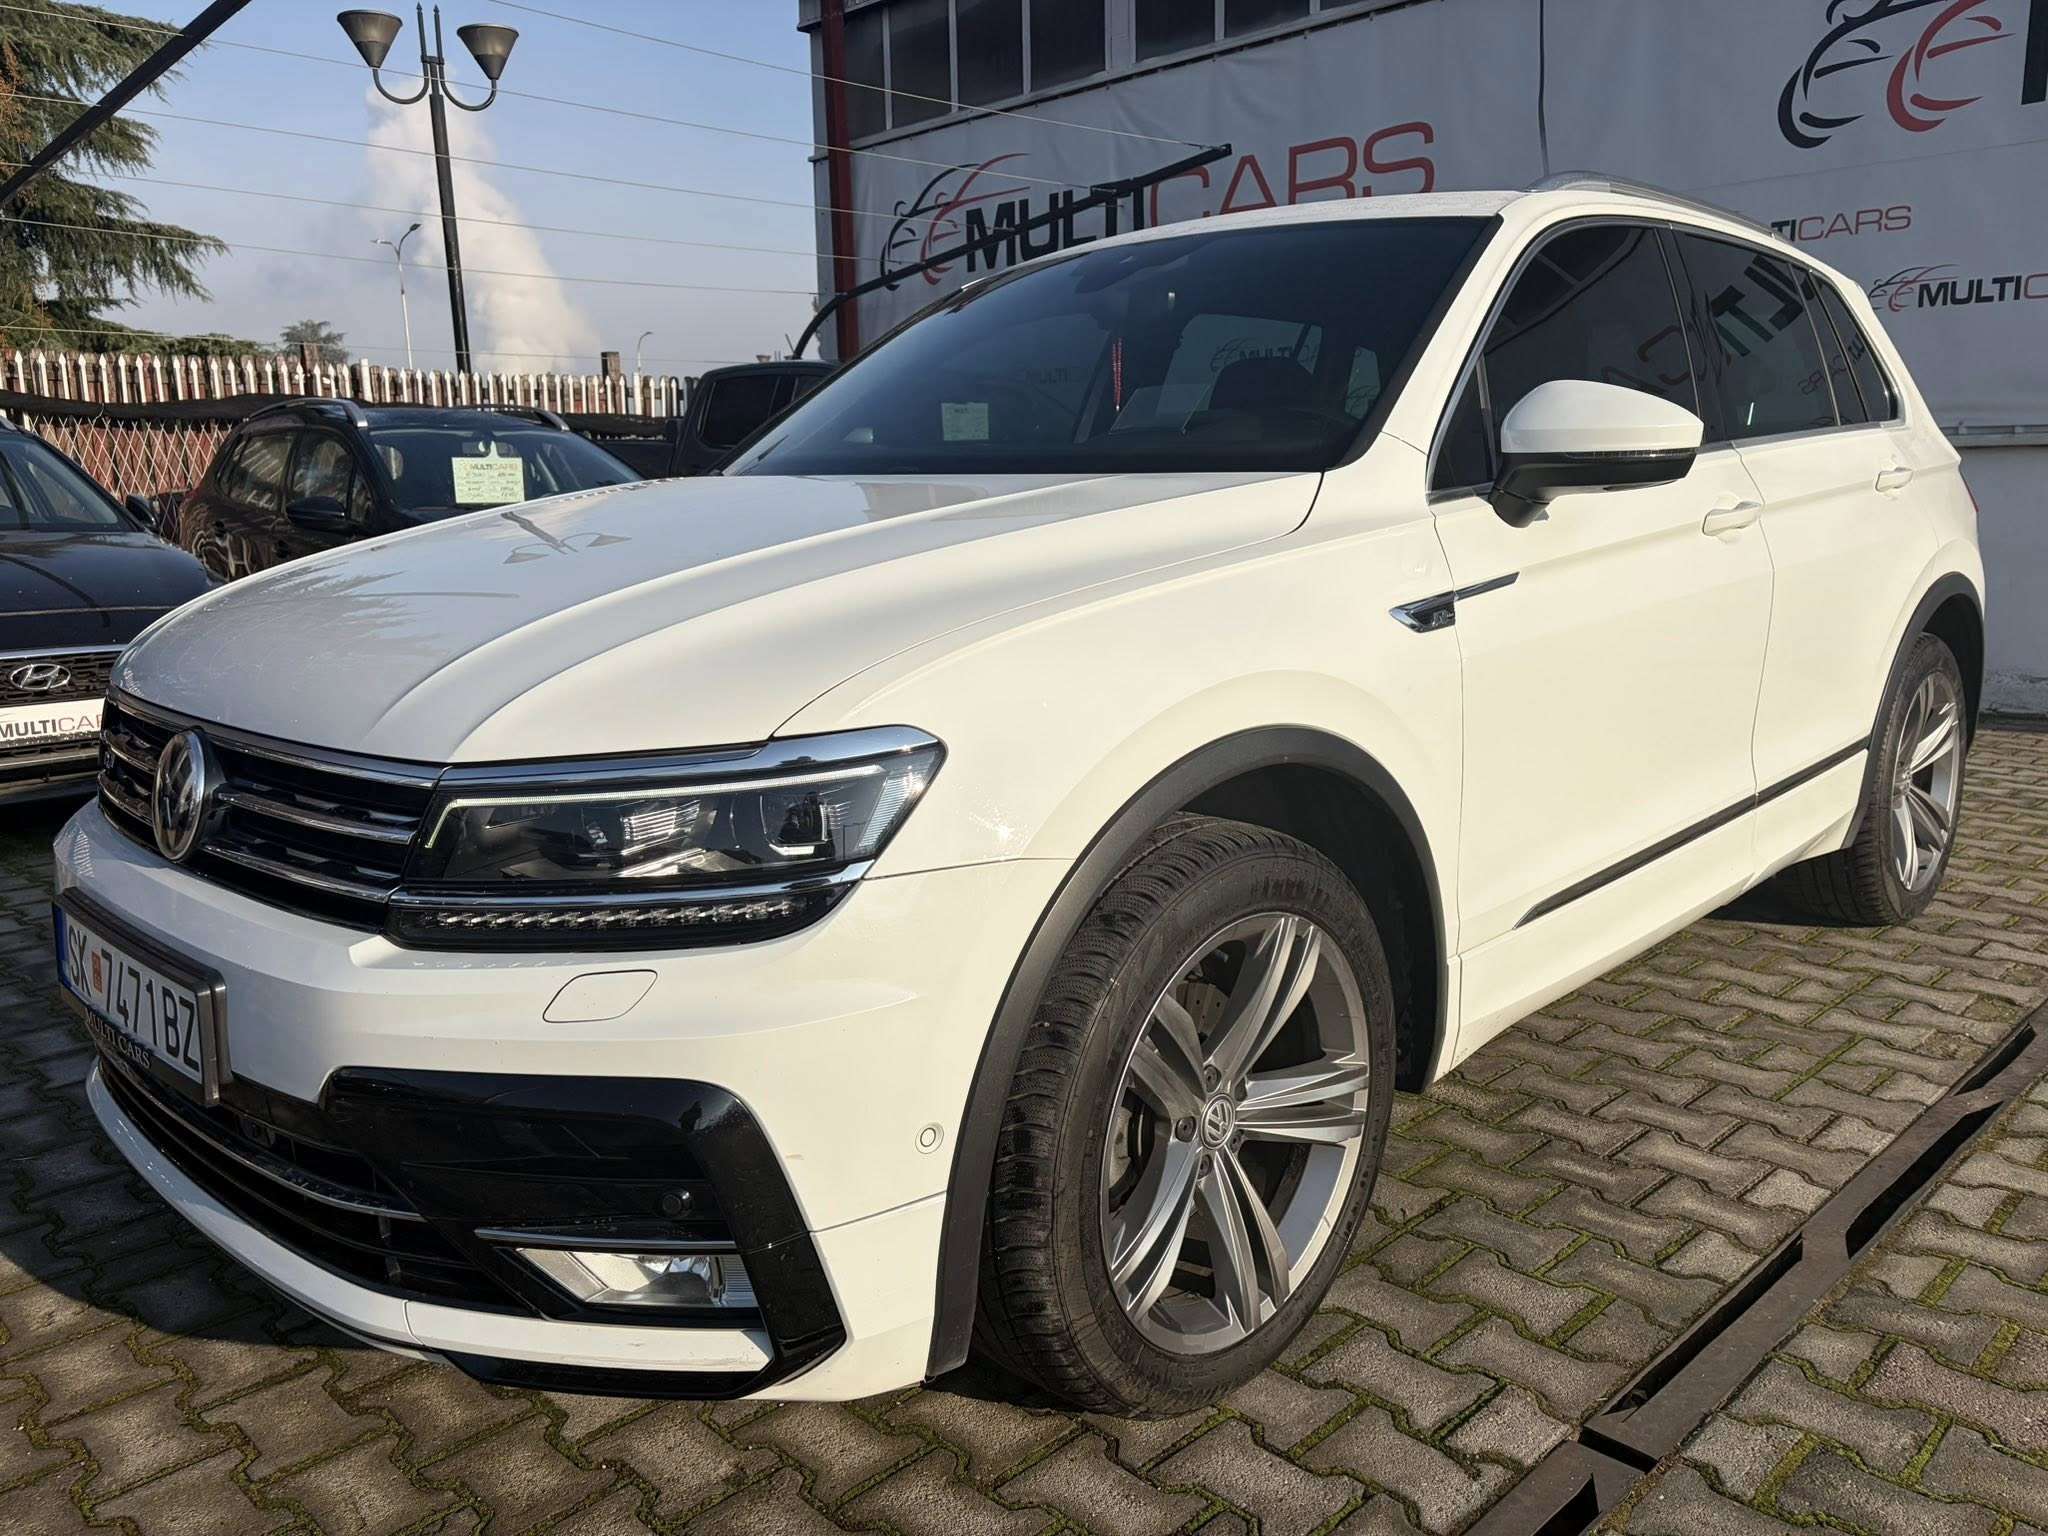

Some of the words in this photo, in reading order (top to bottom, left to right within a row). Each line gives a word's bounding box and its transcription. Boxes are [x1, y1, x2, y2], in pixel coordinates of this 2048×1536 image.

[966, 121, 1434, 272] MULTICARS
[69, 925, 92, 998] SK
[118, 1036, 151, 1069] CARS
